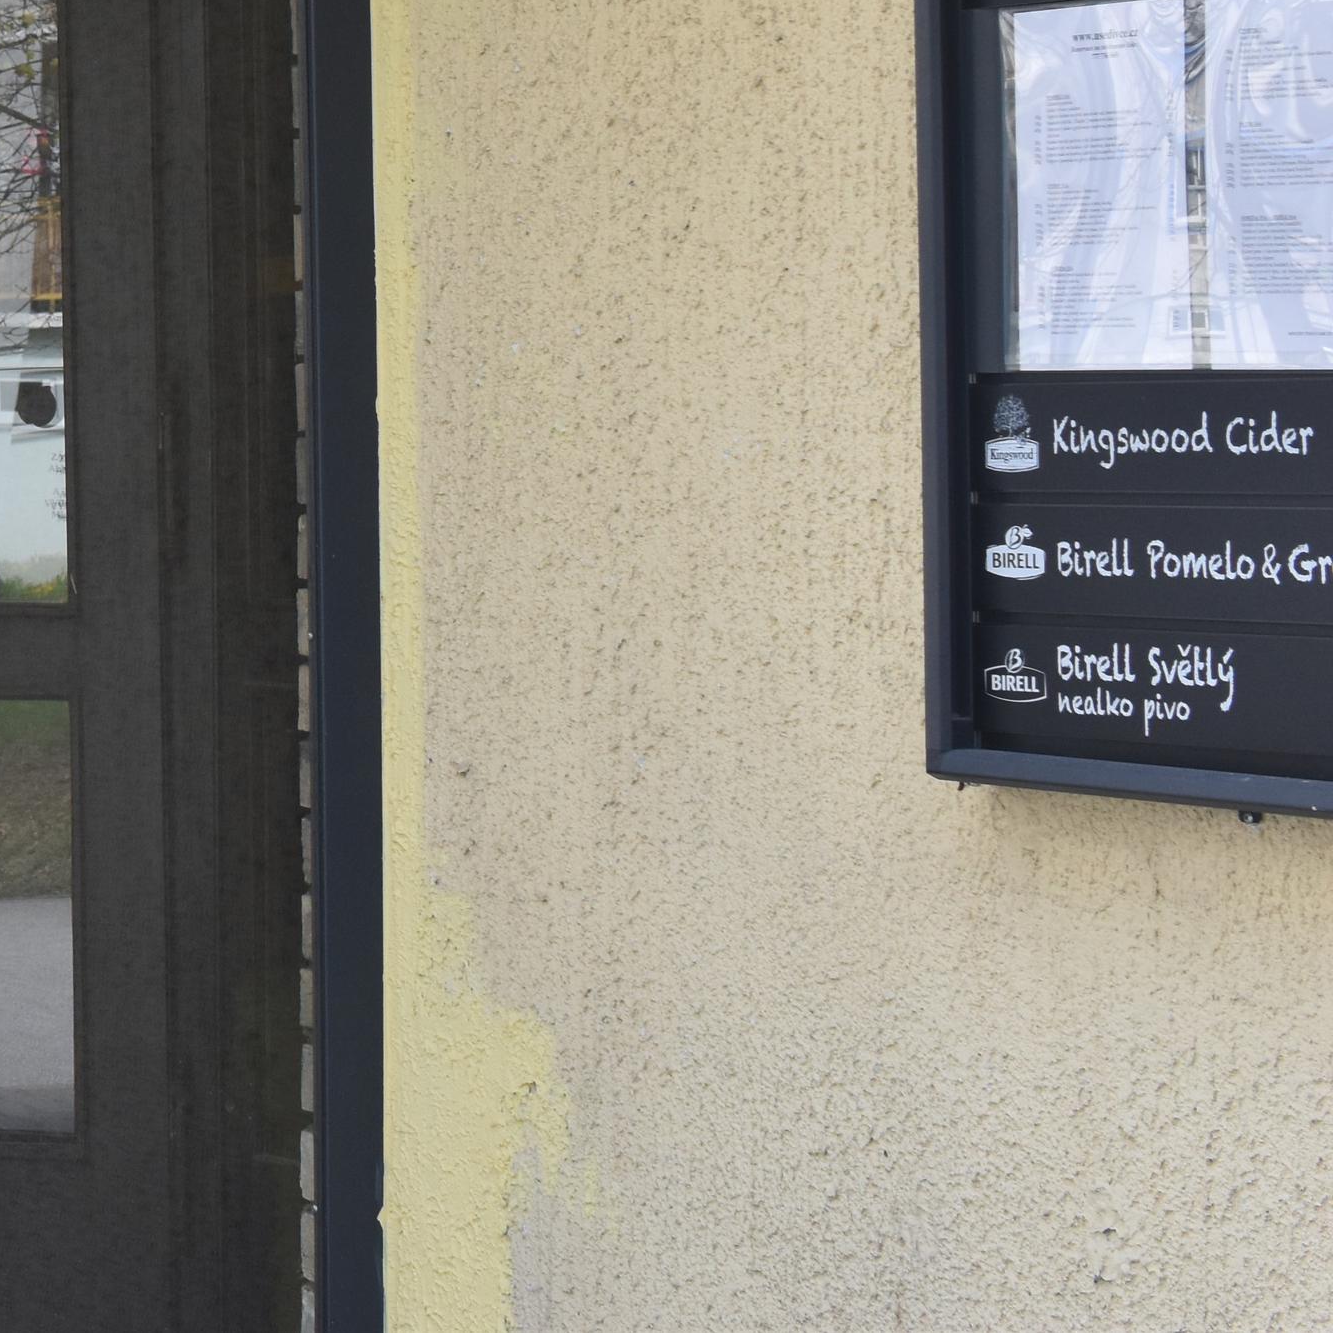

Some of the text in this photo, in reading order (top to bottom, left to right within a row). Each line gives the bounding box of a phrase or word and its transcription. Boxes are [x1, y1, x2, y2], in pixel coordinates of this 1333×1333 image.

[990, 448, 1035, 462] Kingswood
[1053, 410, 1314, 469] Kingswood Cider
[992, 552, 1039, 570] BIRELL
[1056, 538, 1133, 578] Birell
[1146, 540, 1255, 580] Pomelo
[1262, 543, 1282, 585] &
[991, 674, 1039, 693] BIRELL
[1056, 643, 1235, 711] Birell Světlý
[1057, 687, 1190, 737] nealko pivo
